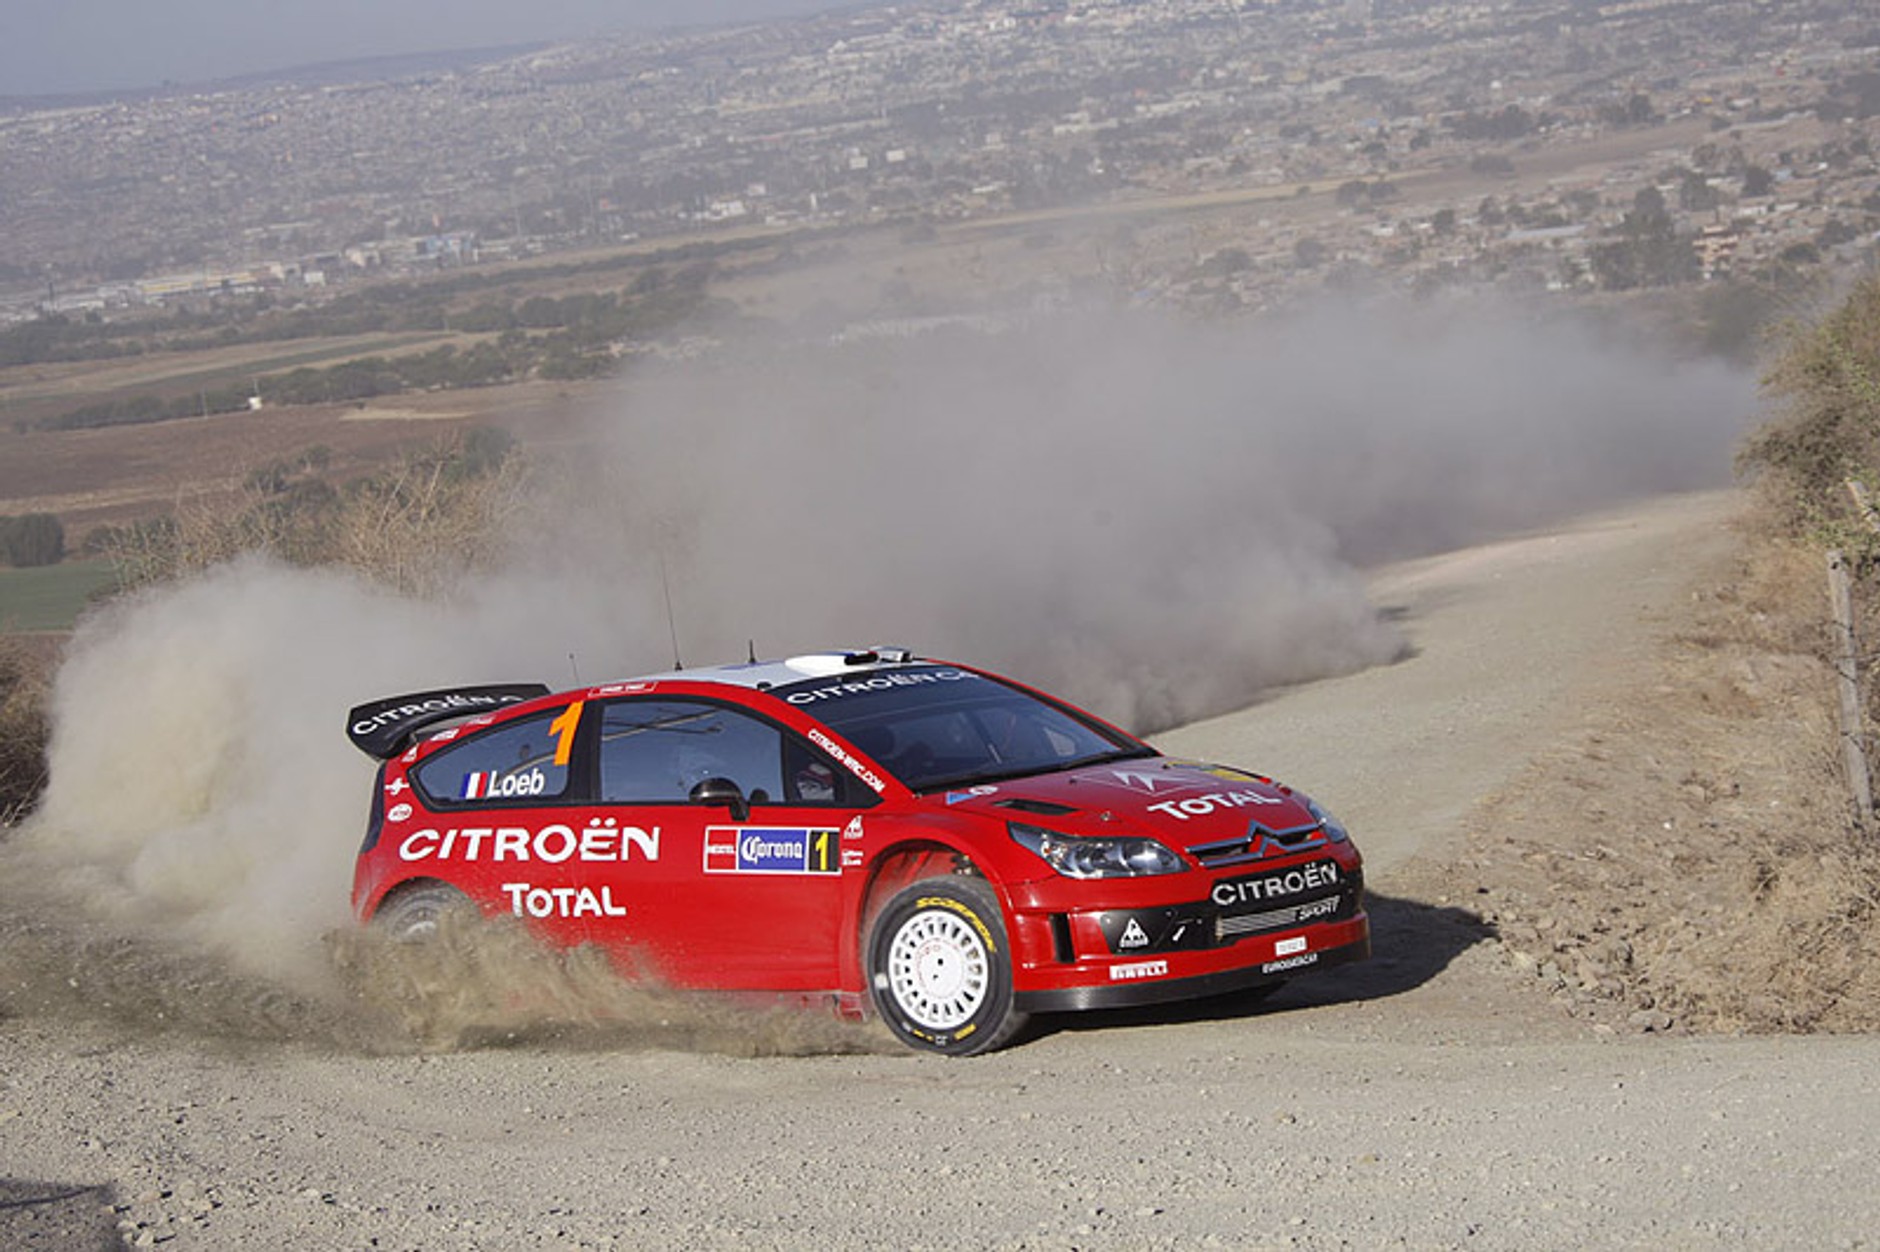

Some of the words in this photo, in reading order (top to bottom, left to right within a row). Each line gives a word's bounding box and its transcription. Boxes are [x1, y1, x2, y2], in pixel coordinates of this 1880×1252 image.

[548, 700, 584, 766] 1
[486, 768, 545, 797] Loeb
[1147, 789, 1282, 820] TOTAL
[399, 817, 660, 863] CITROËN
[741, 836, 803, 864] Corona
[815, 832, 829, 871] 1
[502, 883, 627, 918] TOTAL
[1212, 862, 1338, 905] CITROËN
